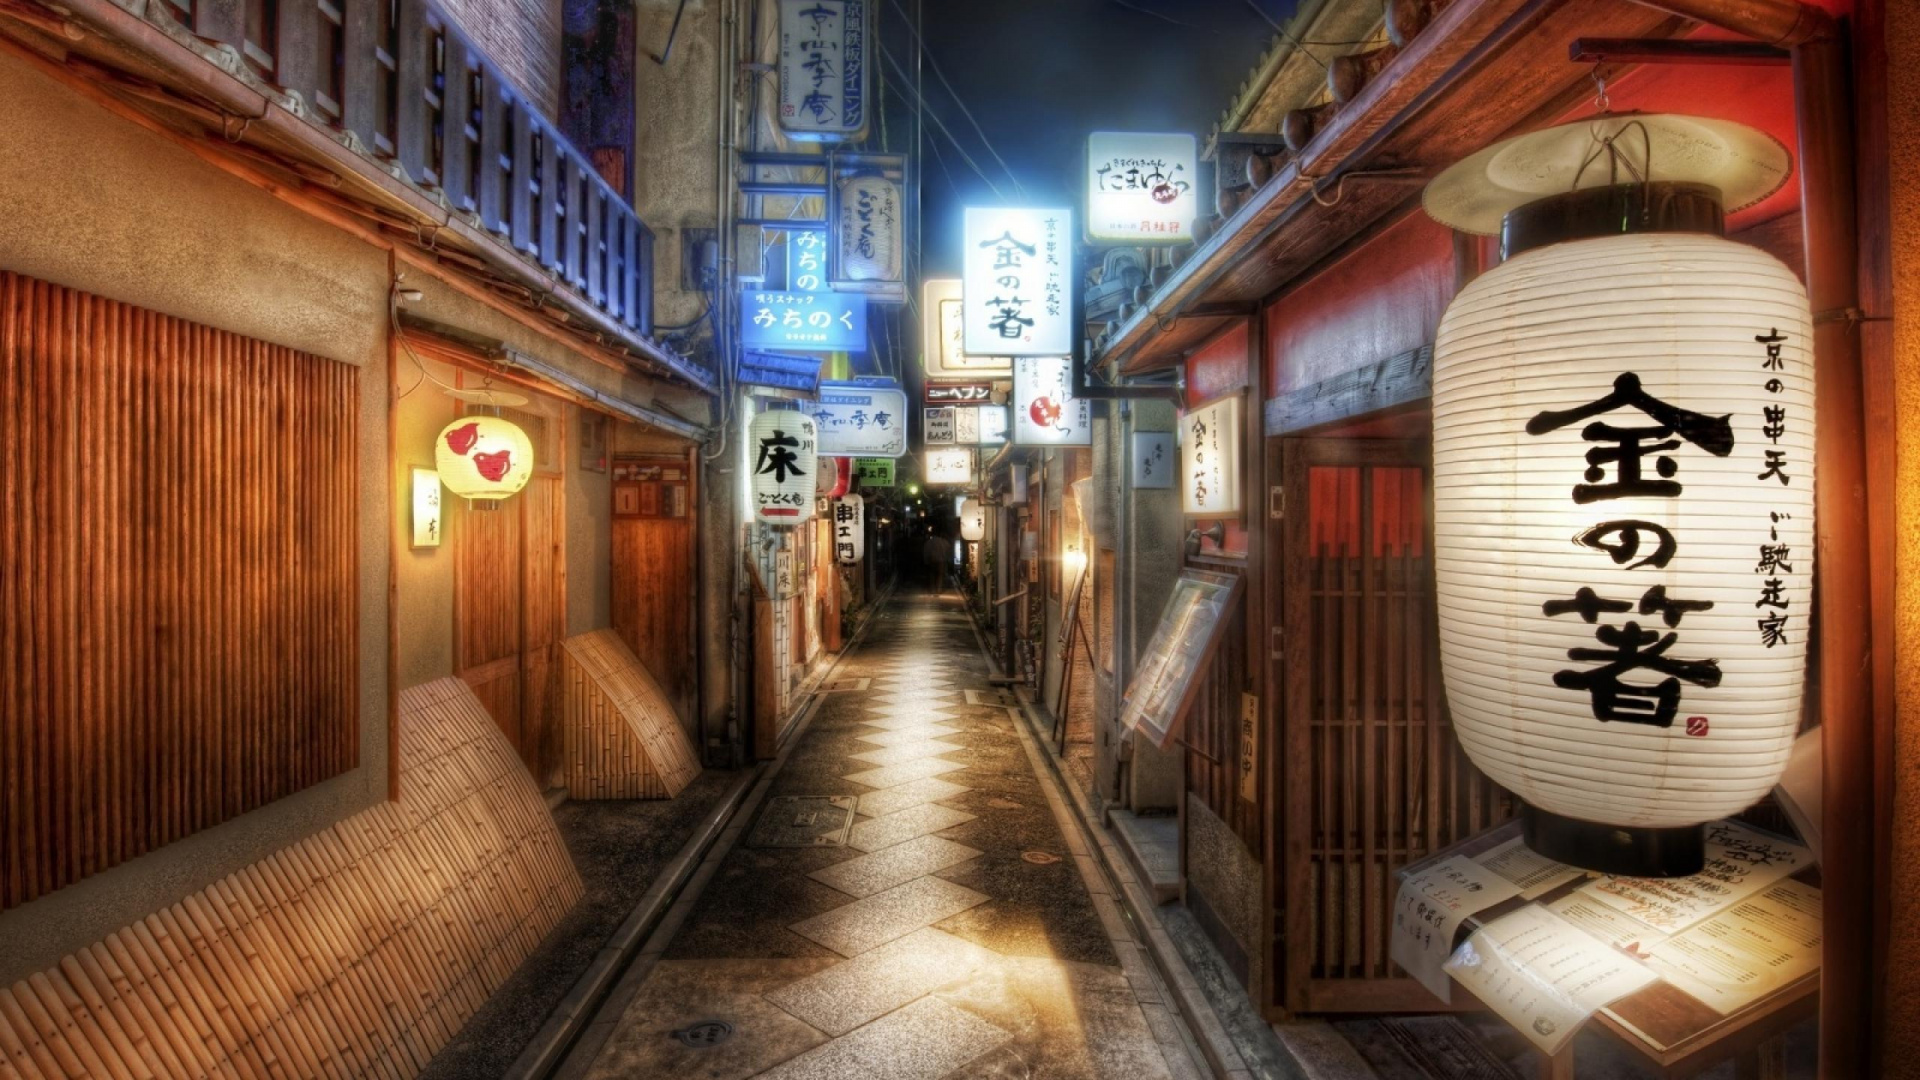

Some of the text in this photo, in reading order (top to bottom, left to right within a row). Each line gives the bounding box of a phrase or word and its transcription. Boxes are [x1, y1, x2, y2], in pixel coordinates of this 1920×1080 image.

[752, 307, 853, 331] みちのく
[1754, 327, 1792, 487] 京の串天
[754, 429, 808, 483] 床
